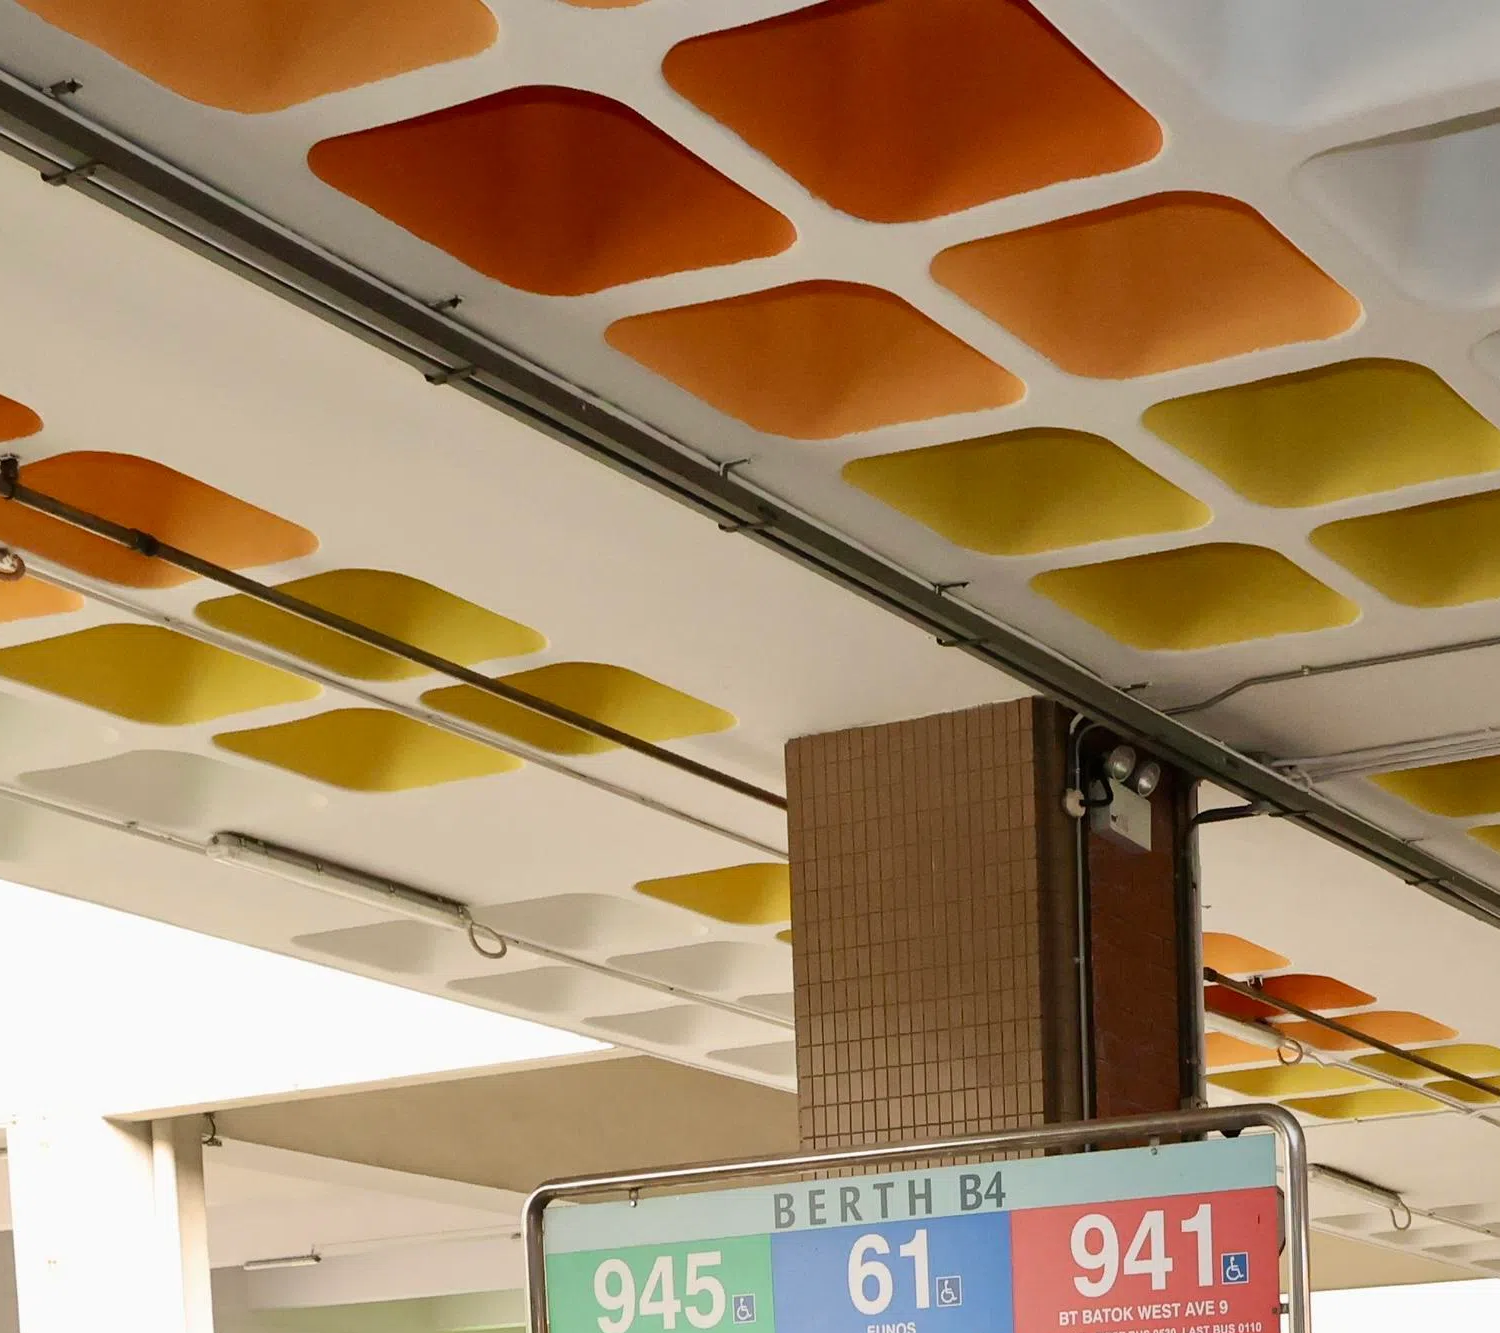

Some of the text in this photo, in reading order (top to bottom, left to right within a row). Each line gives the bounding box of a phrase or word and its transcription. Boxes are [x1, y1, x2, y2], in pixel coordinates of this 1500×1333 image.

[773, 1170, 1006, 1229] BERTH B4
[848, 1229, 930, 1315] 61
[1070, 1203, 1214, 1298] 941
[1059, 1300, 1228, 1325] BT BATOK WEST AVE 9
[1238, 1322, 1261, 1333] 0110
